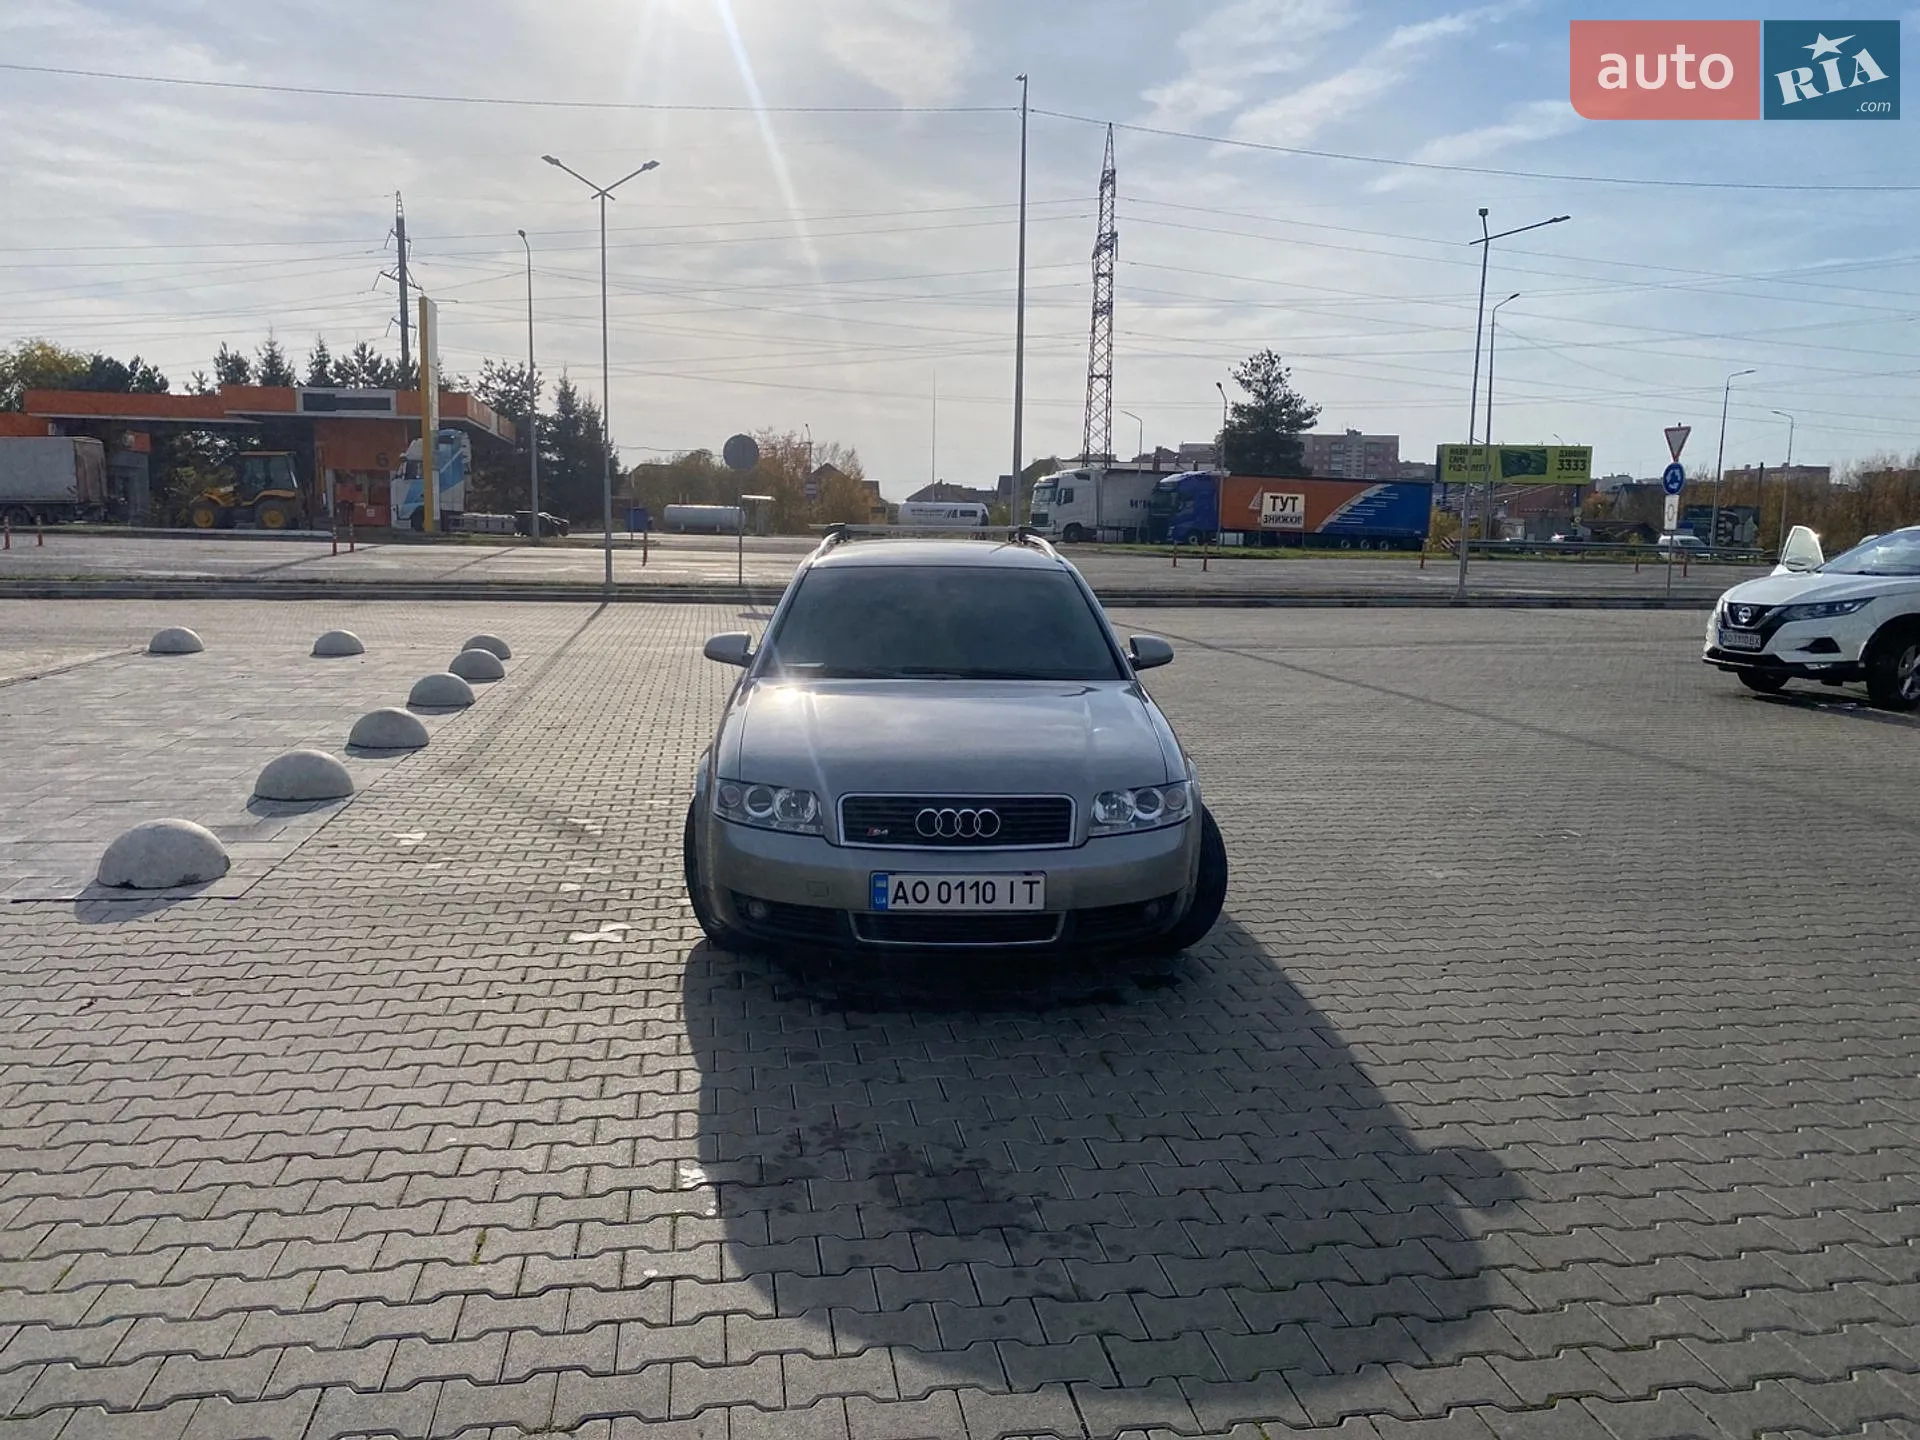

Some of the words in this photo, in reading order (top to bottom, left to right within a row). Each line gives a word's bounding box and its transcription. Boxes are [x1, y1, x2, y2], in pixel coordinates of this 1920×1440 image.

[1557, 459, 1587, 471] 3333
[1269, 495, 1299, 512] ТУТ
[891, 880, 930, 905] AO
[936, 880, 996, 905] 0110
[1008, 880, 1041, 905] IT
